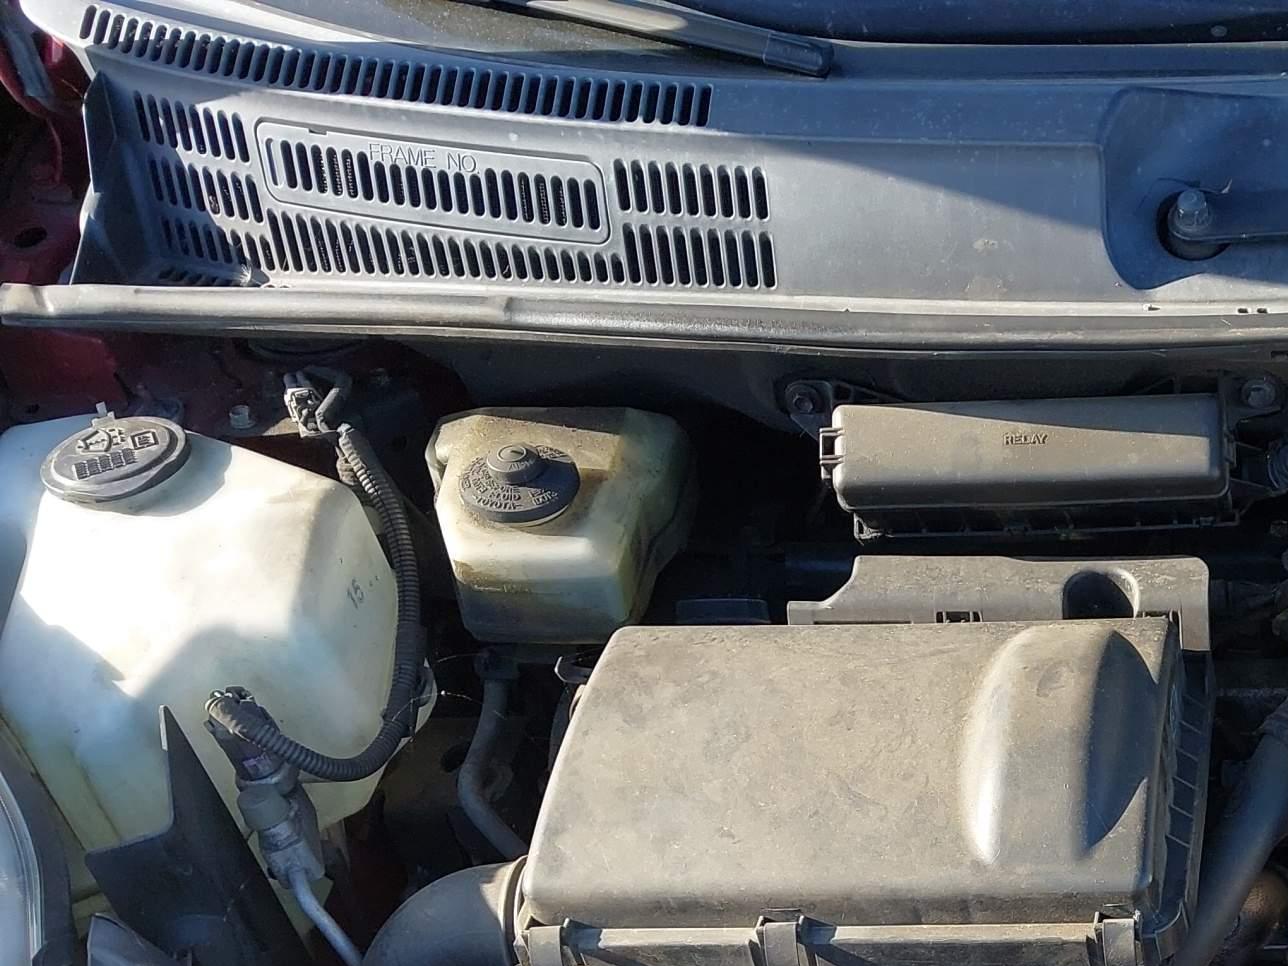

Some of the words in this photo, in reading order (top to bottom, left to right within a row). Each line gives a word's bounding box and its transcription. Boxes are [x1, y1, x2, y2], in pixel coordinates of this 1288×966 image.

[369, 143, 437, 169] FRAME
[446, 152, 480, 174] NO.
[1003, 433, 1048, 446] RELAY
